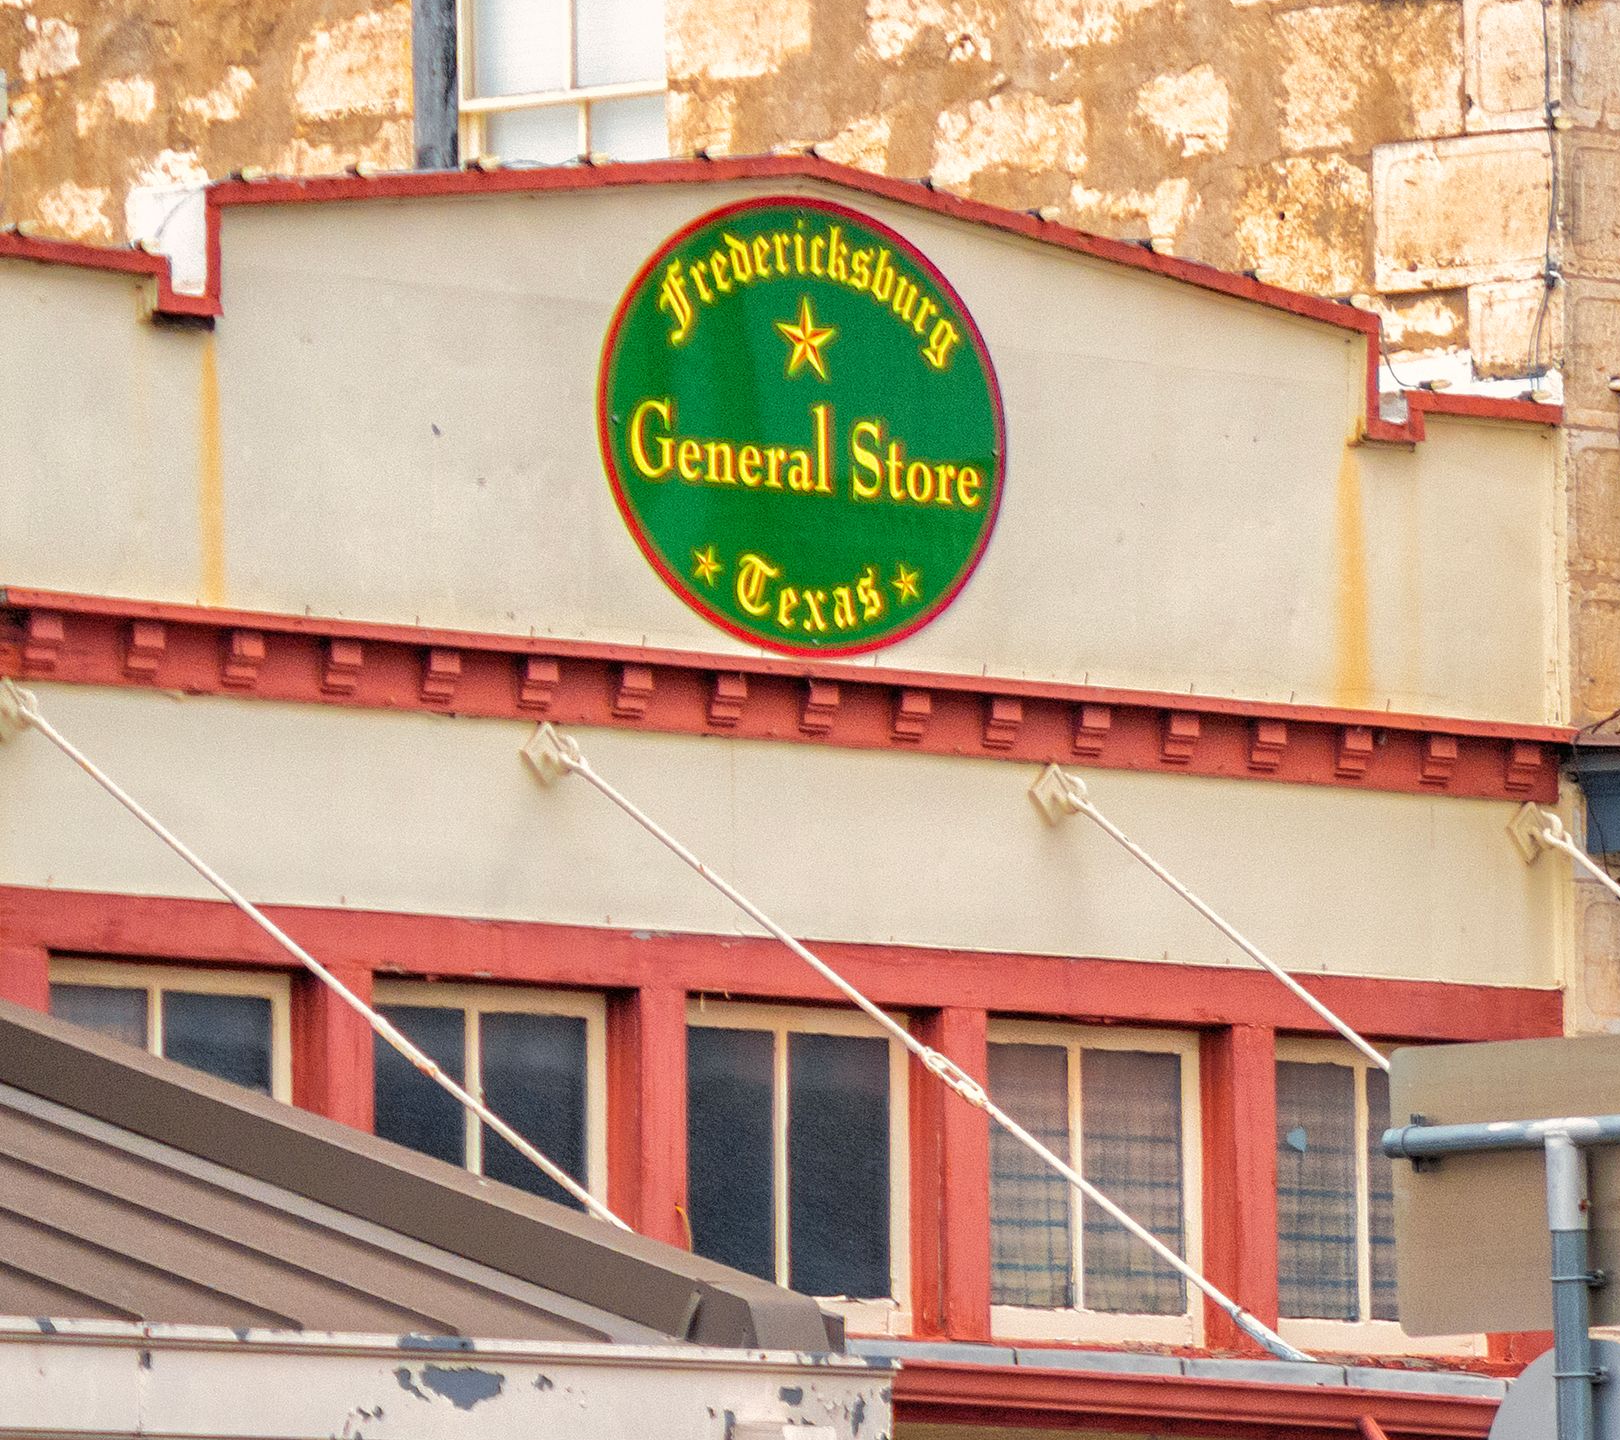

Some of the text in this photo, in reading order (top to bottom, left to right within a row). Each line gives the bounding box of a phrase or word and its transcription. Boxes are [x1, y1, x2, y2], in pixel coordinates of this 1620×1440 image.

[658, 220, 960, 372] Fredericksburg
[630, 397, 983, 508] General Store
[735, 552, 885, 633] Texas
